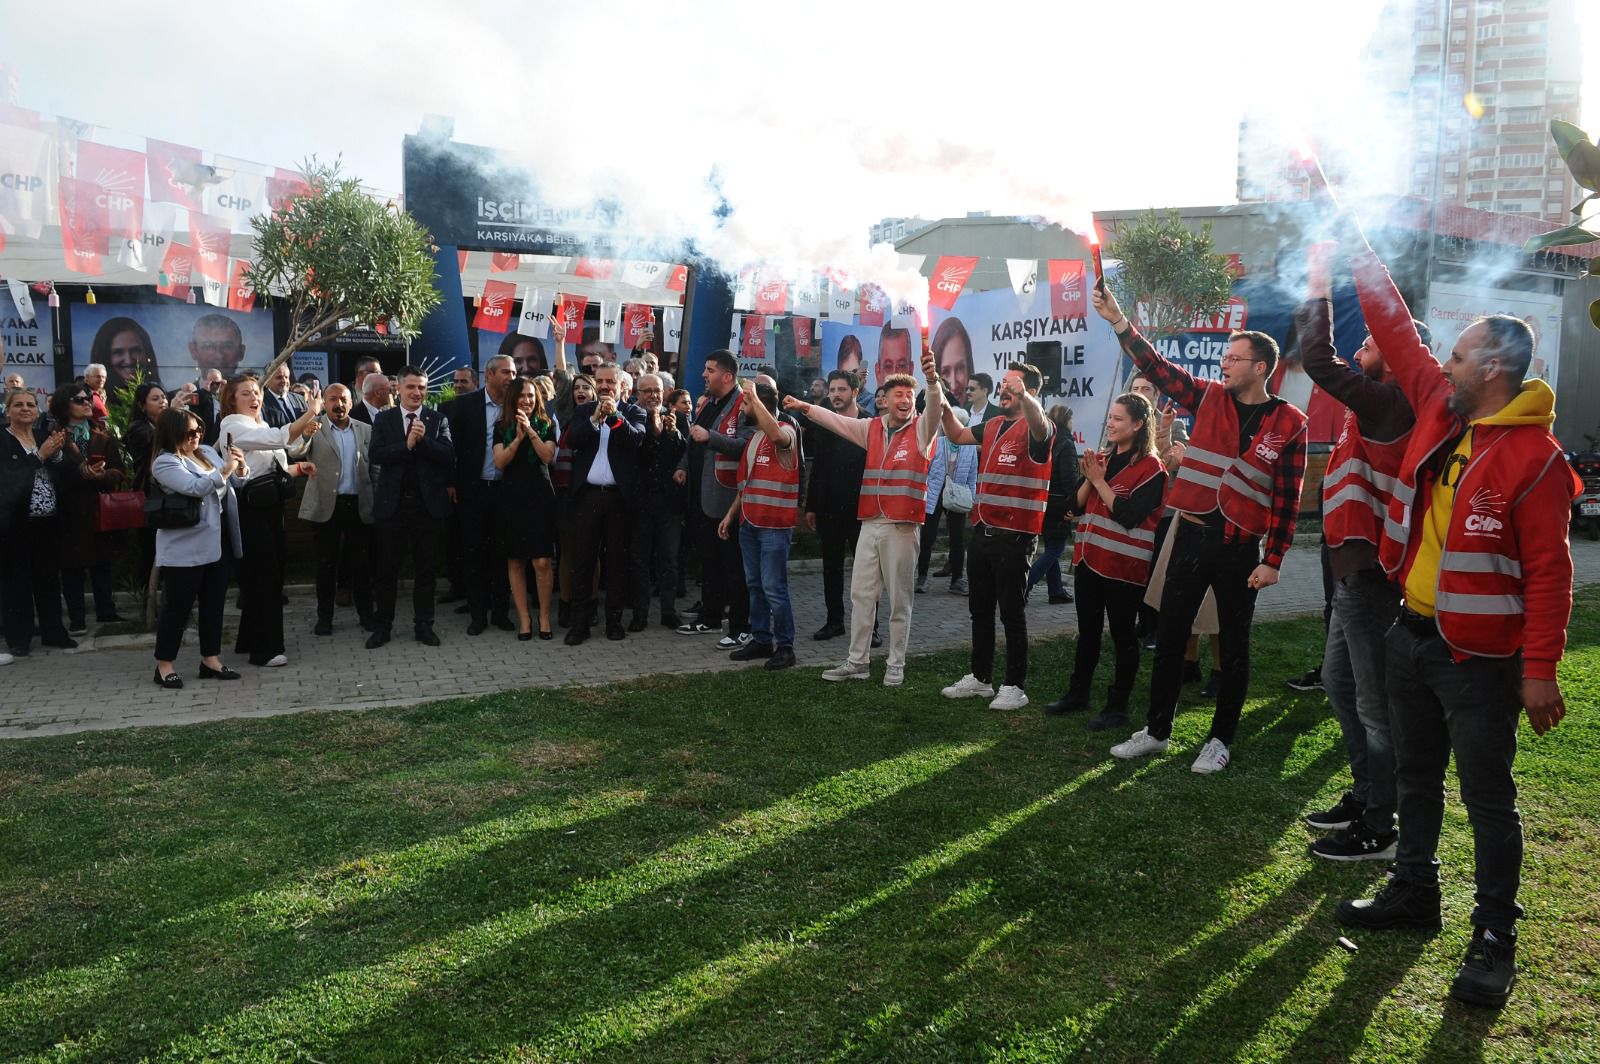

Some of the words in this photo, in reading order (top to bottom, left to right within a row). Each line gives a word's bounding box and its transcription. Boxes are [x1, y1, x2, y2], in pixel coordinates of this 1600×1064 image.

[1, 173, 42, 192] CHP
[95, 194, 135, 212] CHP
[217, 195, 251, 211] CHP
[477, 231, 543, 244] KARŞIYAKA
[168, 272, 189, 285] CHP
[937, 281, 961, 294] CHP
[761, 292, 780, 302] CHP
[1062, 290, 1080, 302] CHP
[483, 306, 504, 317] CHP
[835, 299, 850, 311] CHP
[525, 311, 545, 322] CHP
[604, 319, 616, 329] HP
[991, 312, 1088, 341] KARŞIYAKA
[630, 327, 642, 336] CH
[16, 332, 38, 347] İLE
[4, 352, 46, 364] ACAK
[1256, 443, 1279, 460] CHP
[997, 454, 1017, 464] CHP
[1465, 514, 1503, 531] CHP
